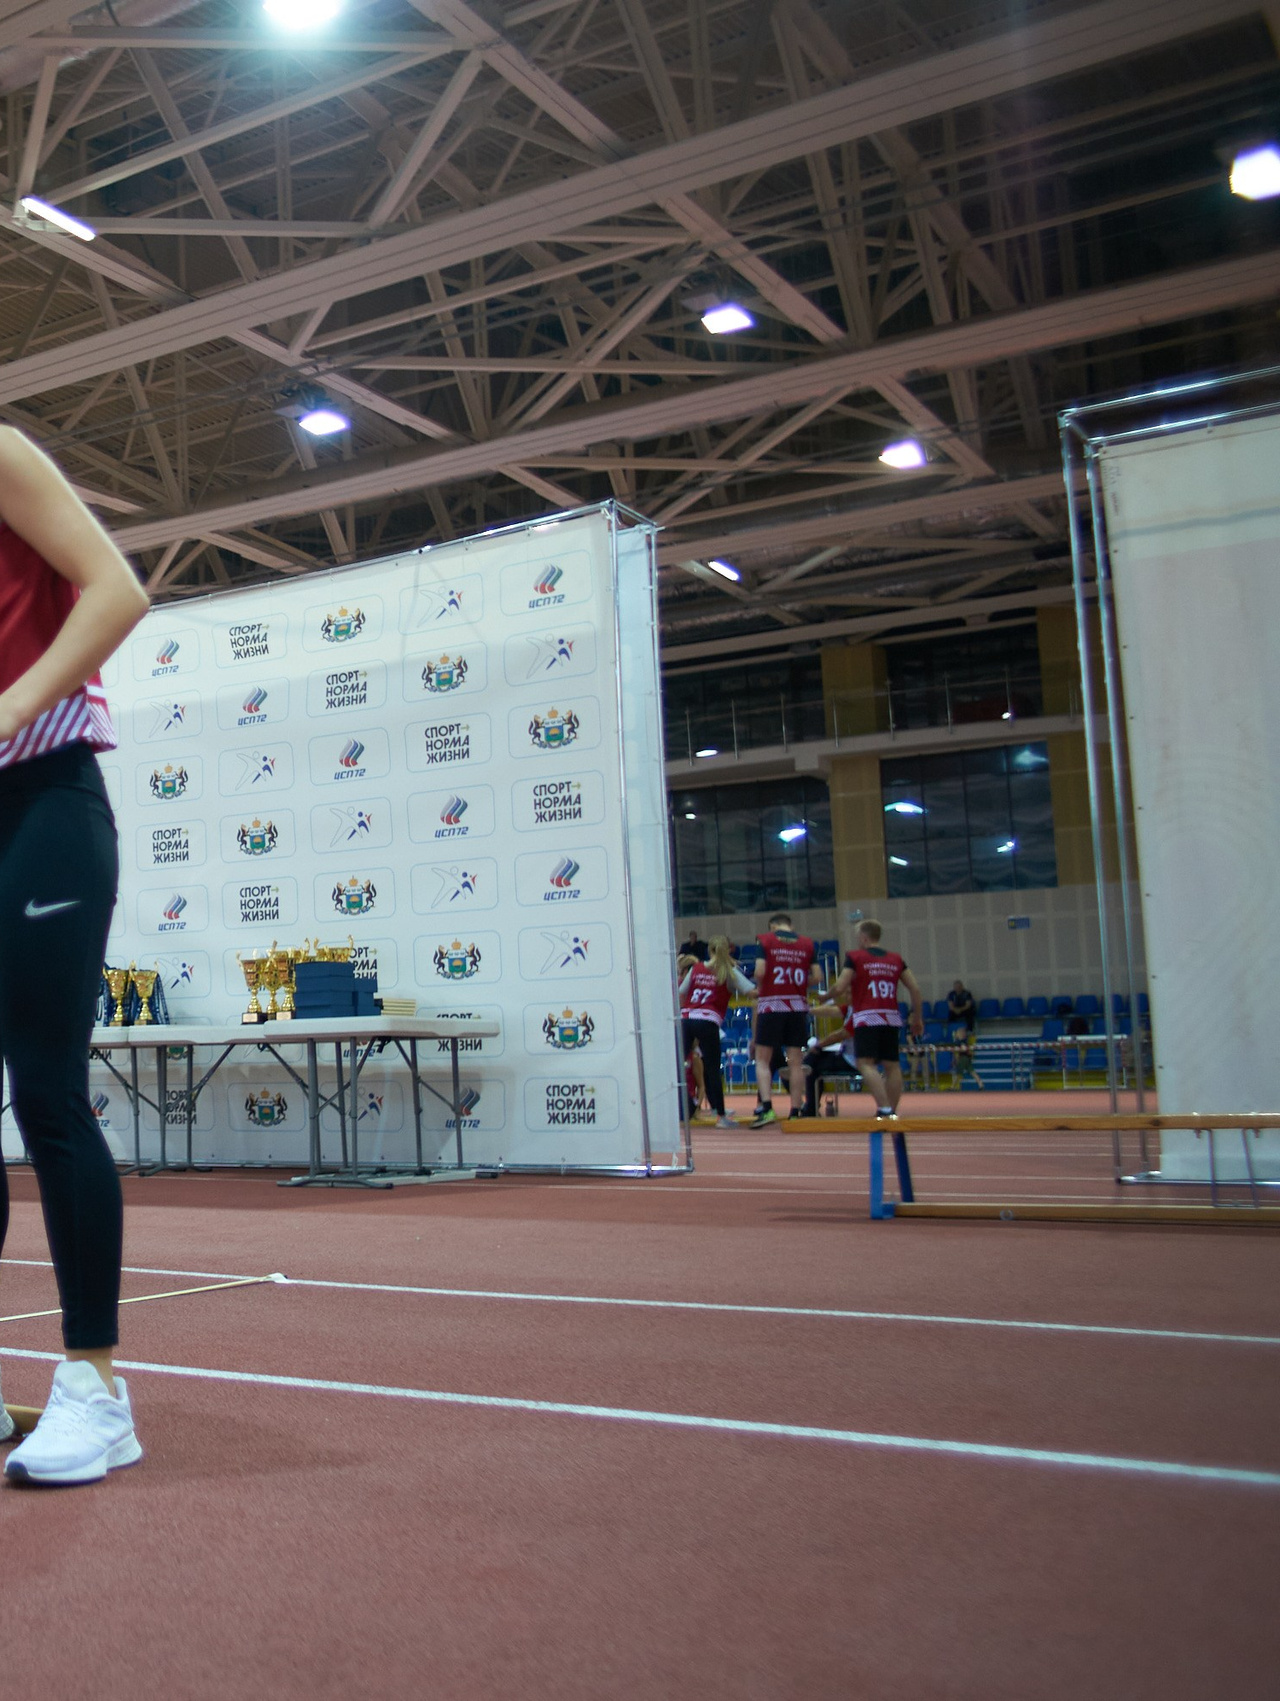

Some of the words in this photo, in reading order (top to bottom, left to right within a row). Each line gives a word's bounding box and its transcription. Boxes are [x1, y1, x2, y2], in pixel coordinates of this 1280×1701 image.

[229, 623, 262, 635] СПОРТ
[230, 633, 268, 648] НОРМА
[233, 644, 269, 660] ЖИЗНИ
[326, 670, 359, 685] СПОРТ
[326, 681, 367, 698] НОРМА
[326, 694, 366, 710] ЖИЗНИ
[425, 723, 461, 738] СПОРТ
[426, 735, 470, 752] НОРМА
[427, 748, 470, 764] ЖИЗНИ
[533, 781, 572, 796] СПОРТ
[534, 794, 581, 810] НОРМА
[535, 807, 582, 824] ЖИЗНИ
[152, 828, 182, 840] СПОРТ
[153, 839, 189, 852] НОРМА
[153, 850, 189, 864] ЖИЗНИ
[240, 885, 272, 898] СПОРТ
[240, 896, 279, 910] НОРМА
[241, 909, 280, 922] ЖИЗНИ
[350, 947, 369, 958] ОРТ
[773, 966, 805, 986] 210
[438, 1039, 482, 1052] ЖЗНИ
[546, 1084, 585, 1097] СПОРТ
[547, 1098, 596, 1110] НОРМА
[548, 1112, 596, 1124] ЖИЗНИ
